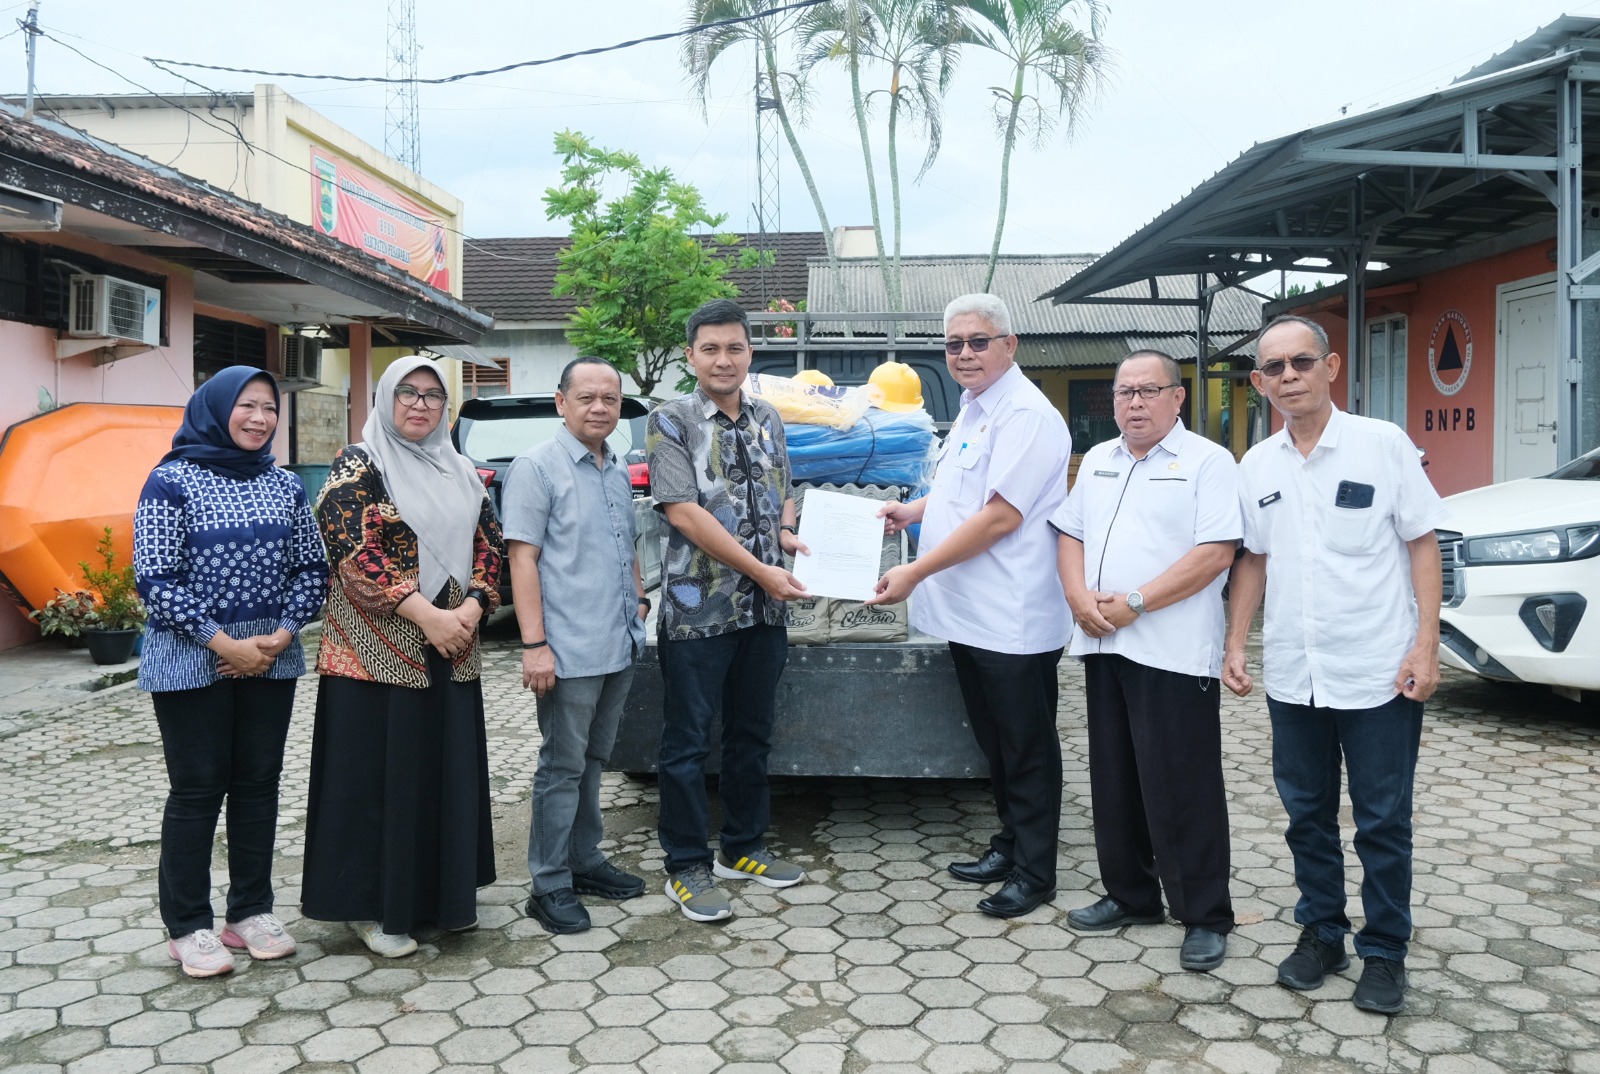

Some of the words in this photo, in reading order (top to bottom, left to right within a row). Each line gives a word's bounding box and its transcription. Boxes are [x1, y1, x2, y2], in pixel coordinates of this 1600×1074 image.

[1430, 316, 1445, 345] BADAN
[1446, 311, 1470, 341] NASIONAL
[1425, 407, 1475, 432] BNPB
